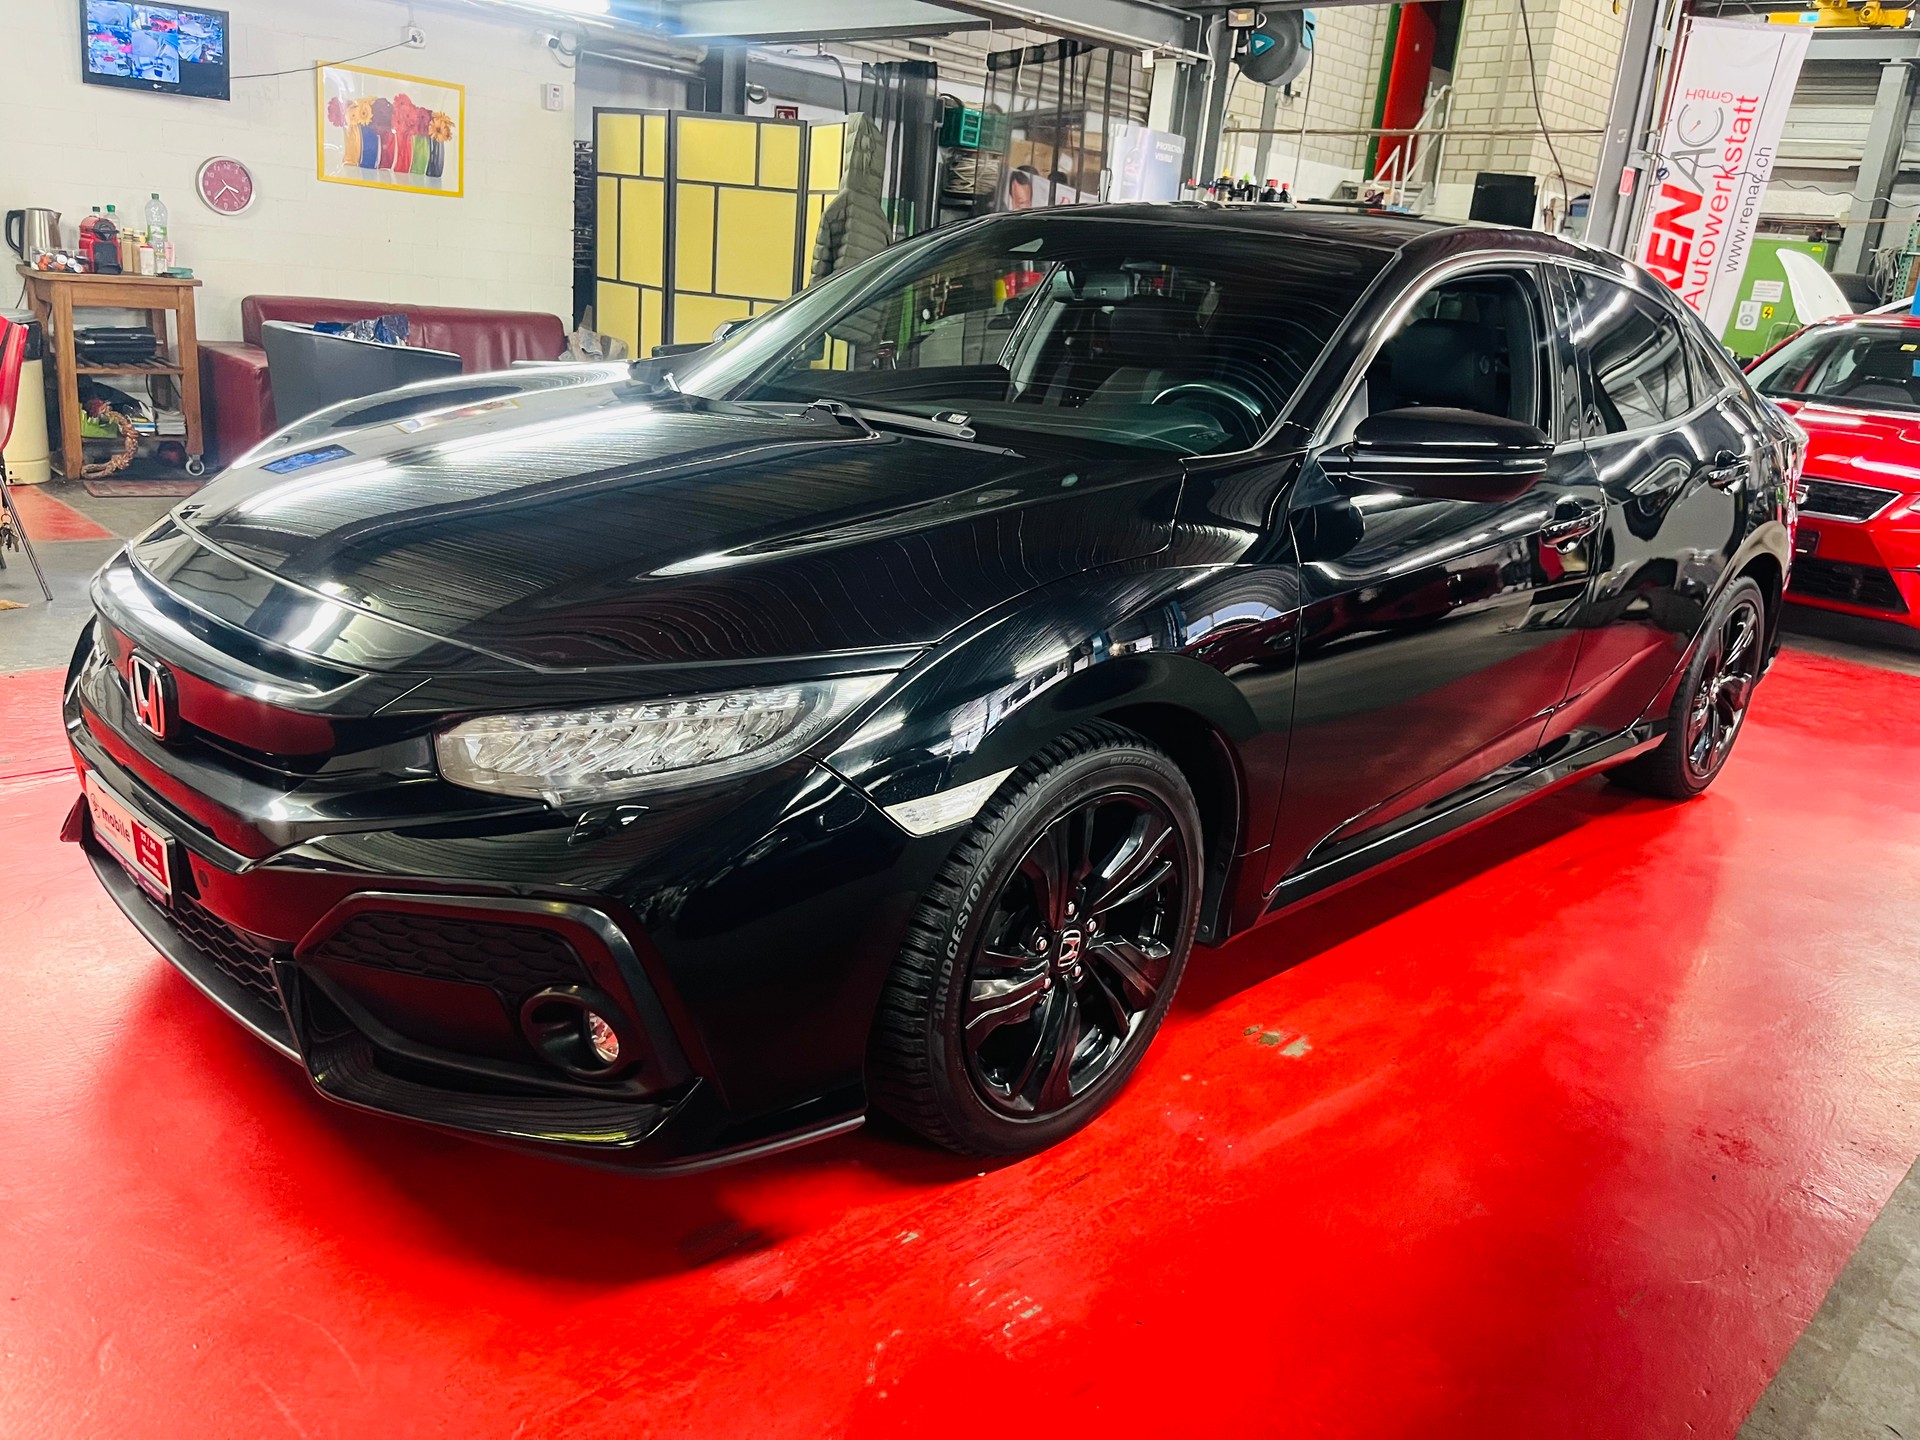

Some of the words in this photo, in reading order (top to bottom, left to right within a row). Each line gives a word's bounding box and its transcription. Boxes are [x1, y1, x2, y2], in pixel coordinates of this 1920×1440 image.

[1684, 88, 1734, 104] GmbH
[1683, 95, 1759, 311] Autowerkstatt
[1725, 146, 1772, 273] www.renac.ch
[101, 807, 131, 843] mobile
[933, 855, 998, 1020] BRIDGESTONE
